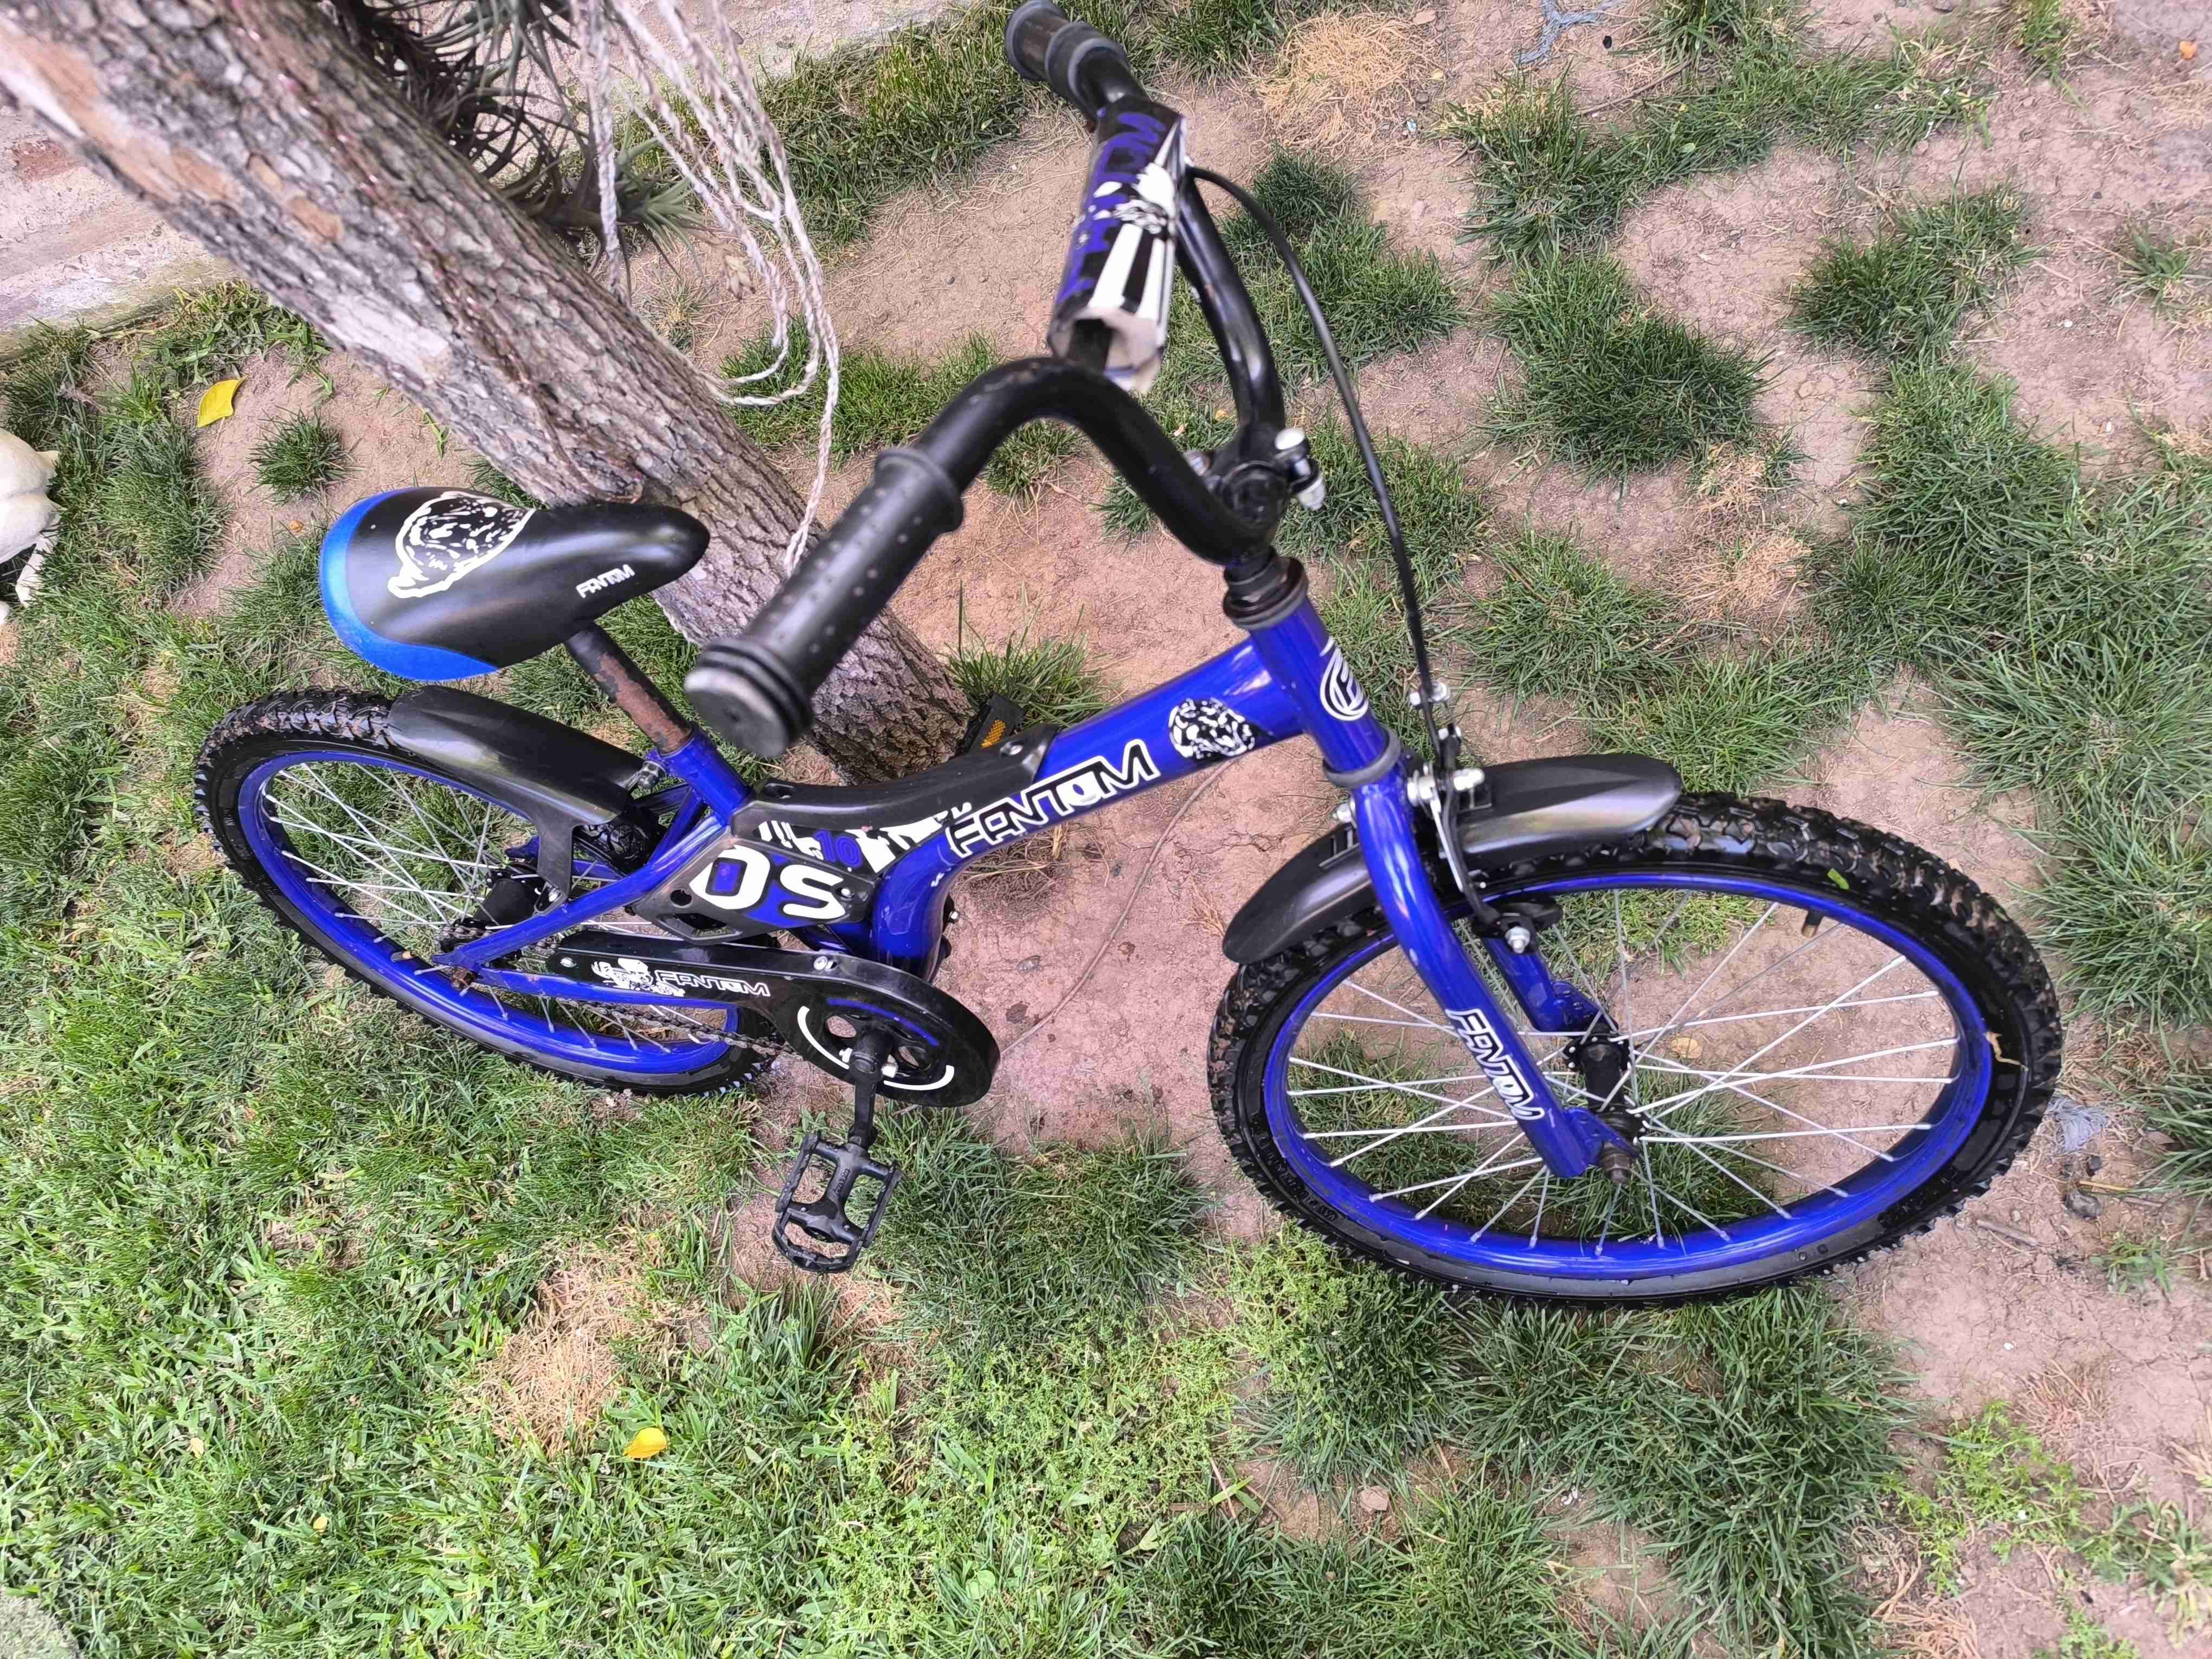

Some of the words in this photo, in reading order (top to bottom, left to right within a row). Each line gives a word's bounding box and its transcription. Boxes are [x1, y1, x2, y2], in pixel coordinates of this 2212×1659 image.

[576, 564, 635, 599] FANTOM
[946, 739, 1161, 858] FANTOM
[654, 969, 770, 997] FANTOM
